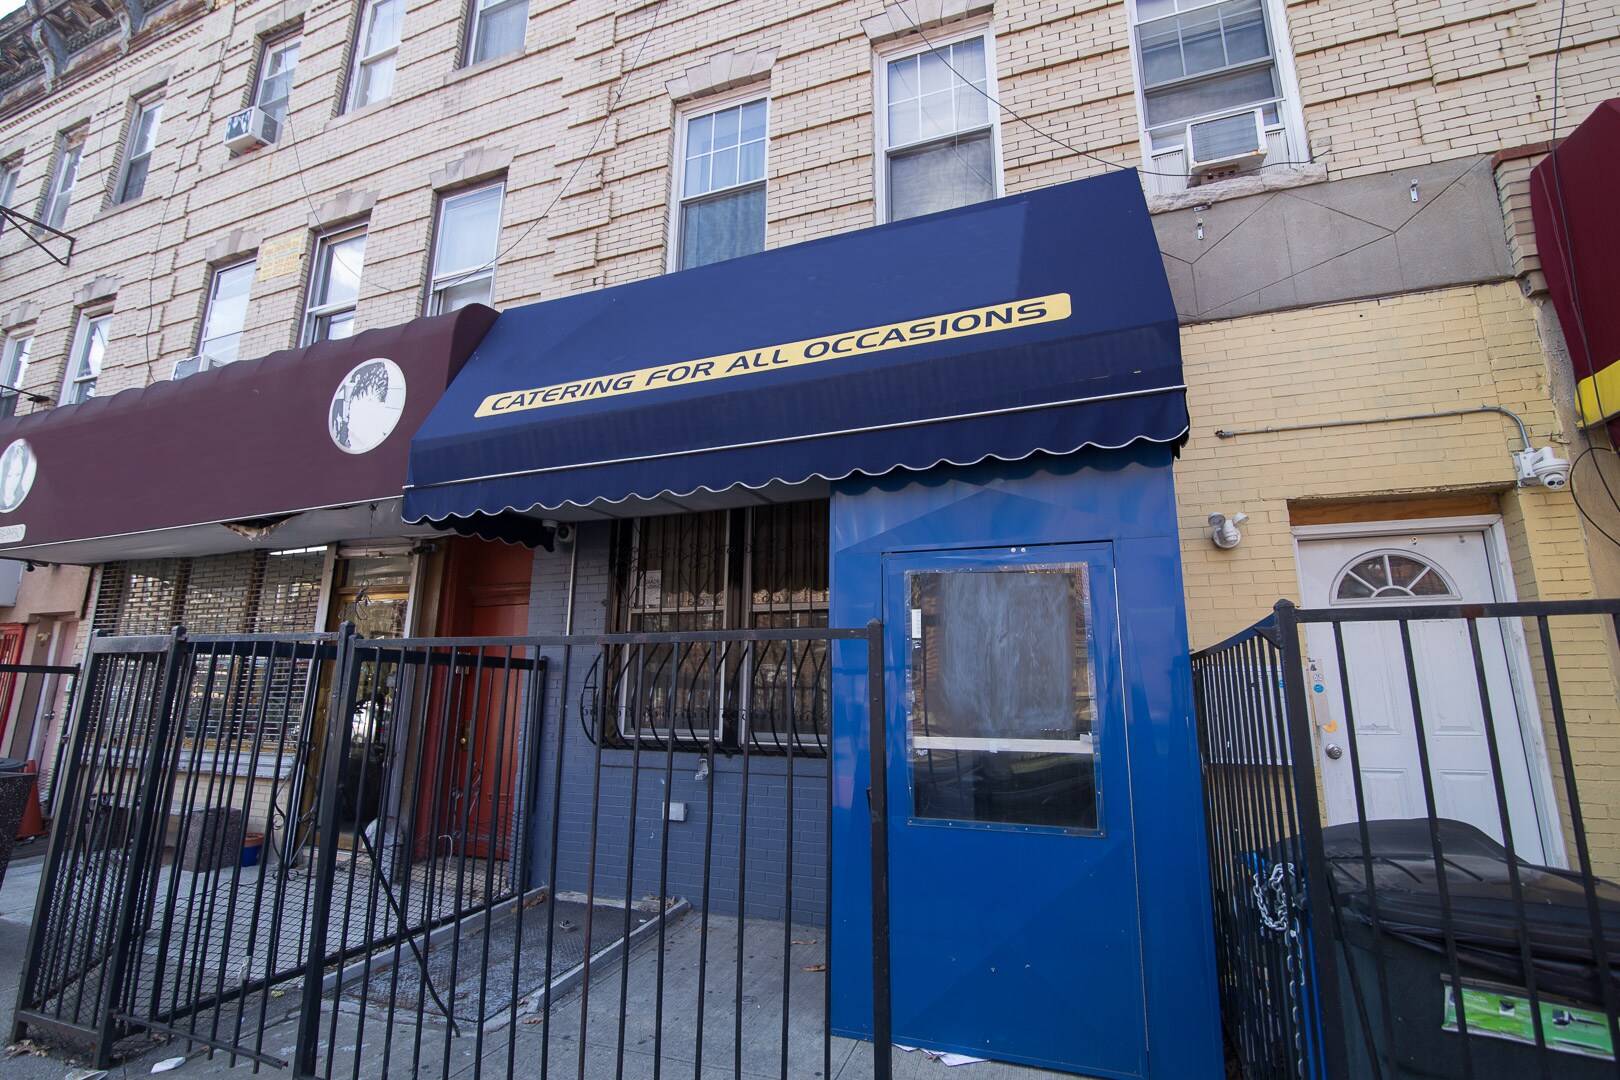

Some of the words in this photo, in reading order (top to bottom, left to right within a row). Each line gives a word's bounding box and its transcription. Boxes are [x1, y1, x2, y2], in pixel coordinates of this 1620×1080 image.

[490, 374, 636, 411] CATERING
[645, 361, 715, 387] FOR
[725, 348, 789, 373] ALL
[803, 301, 1047, 359] OCCASIONS
